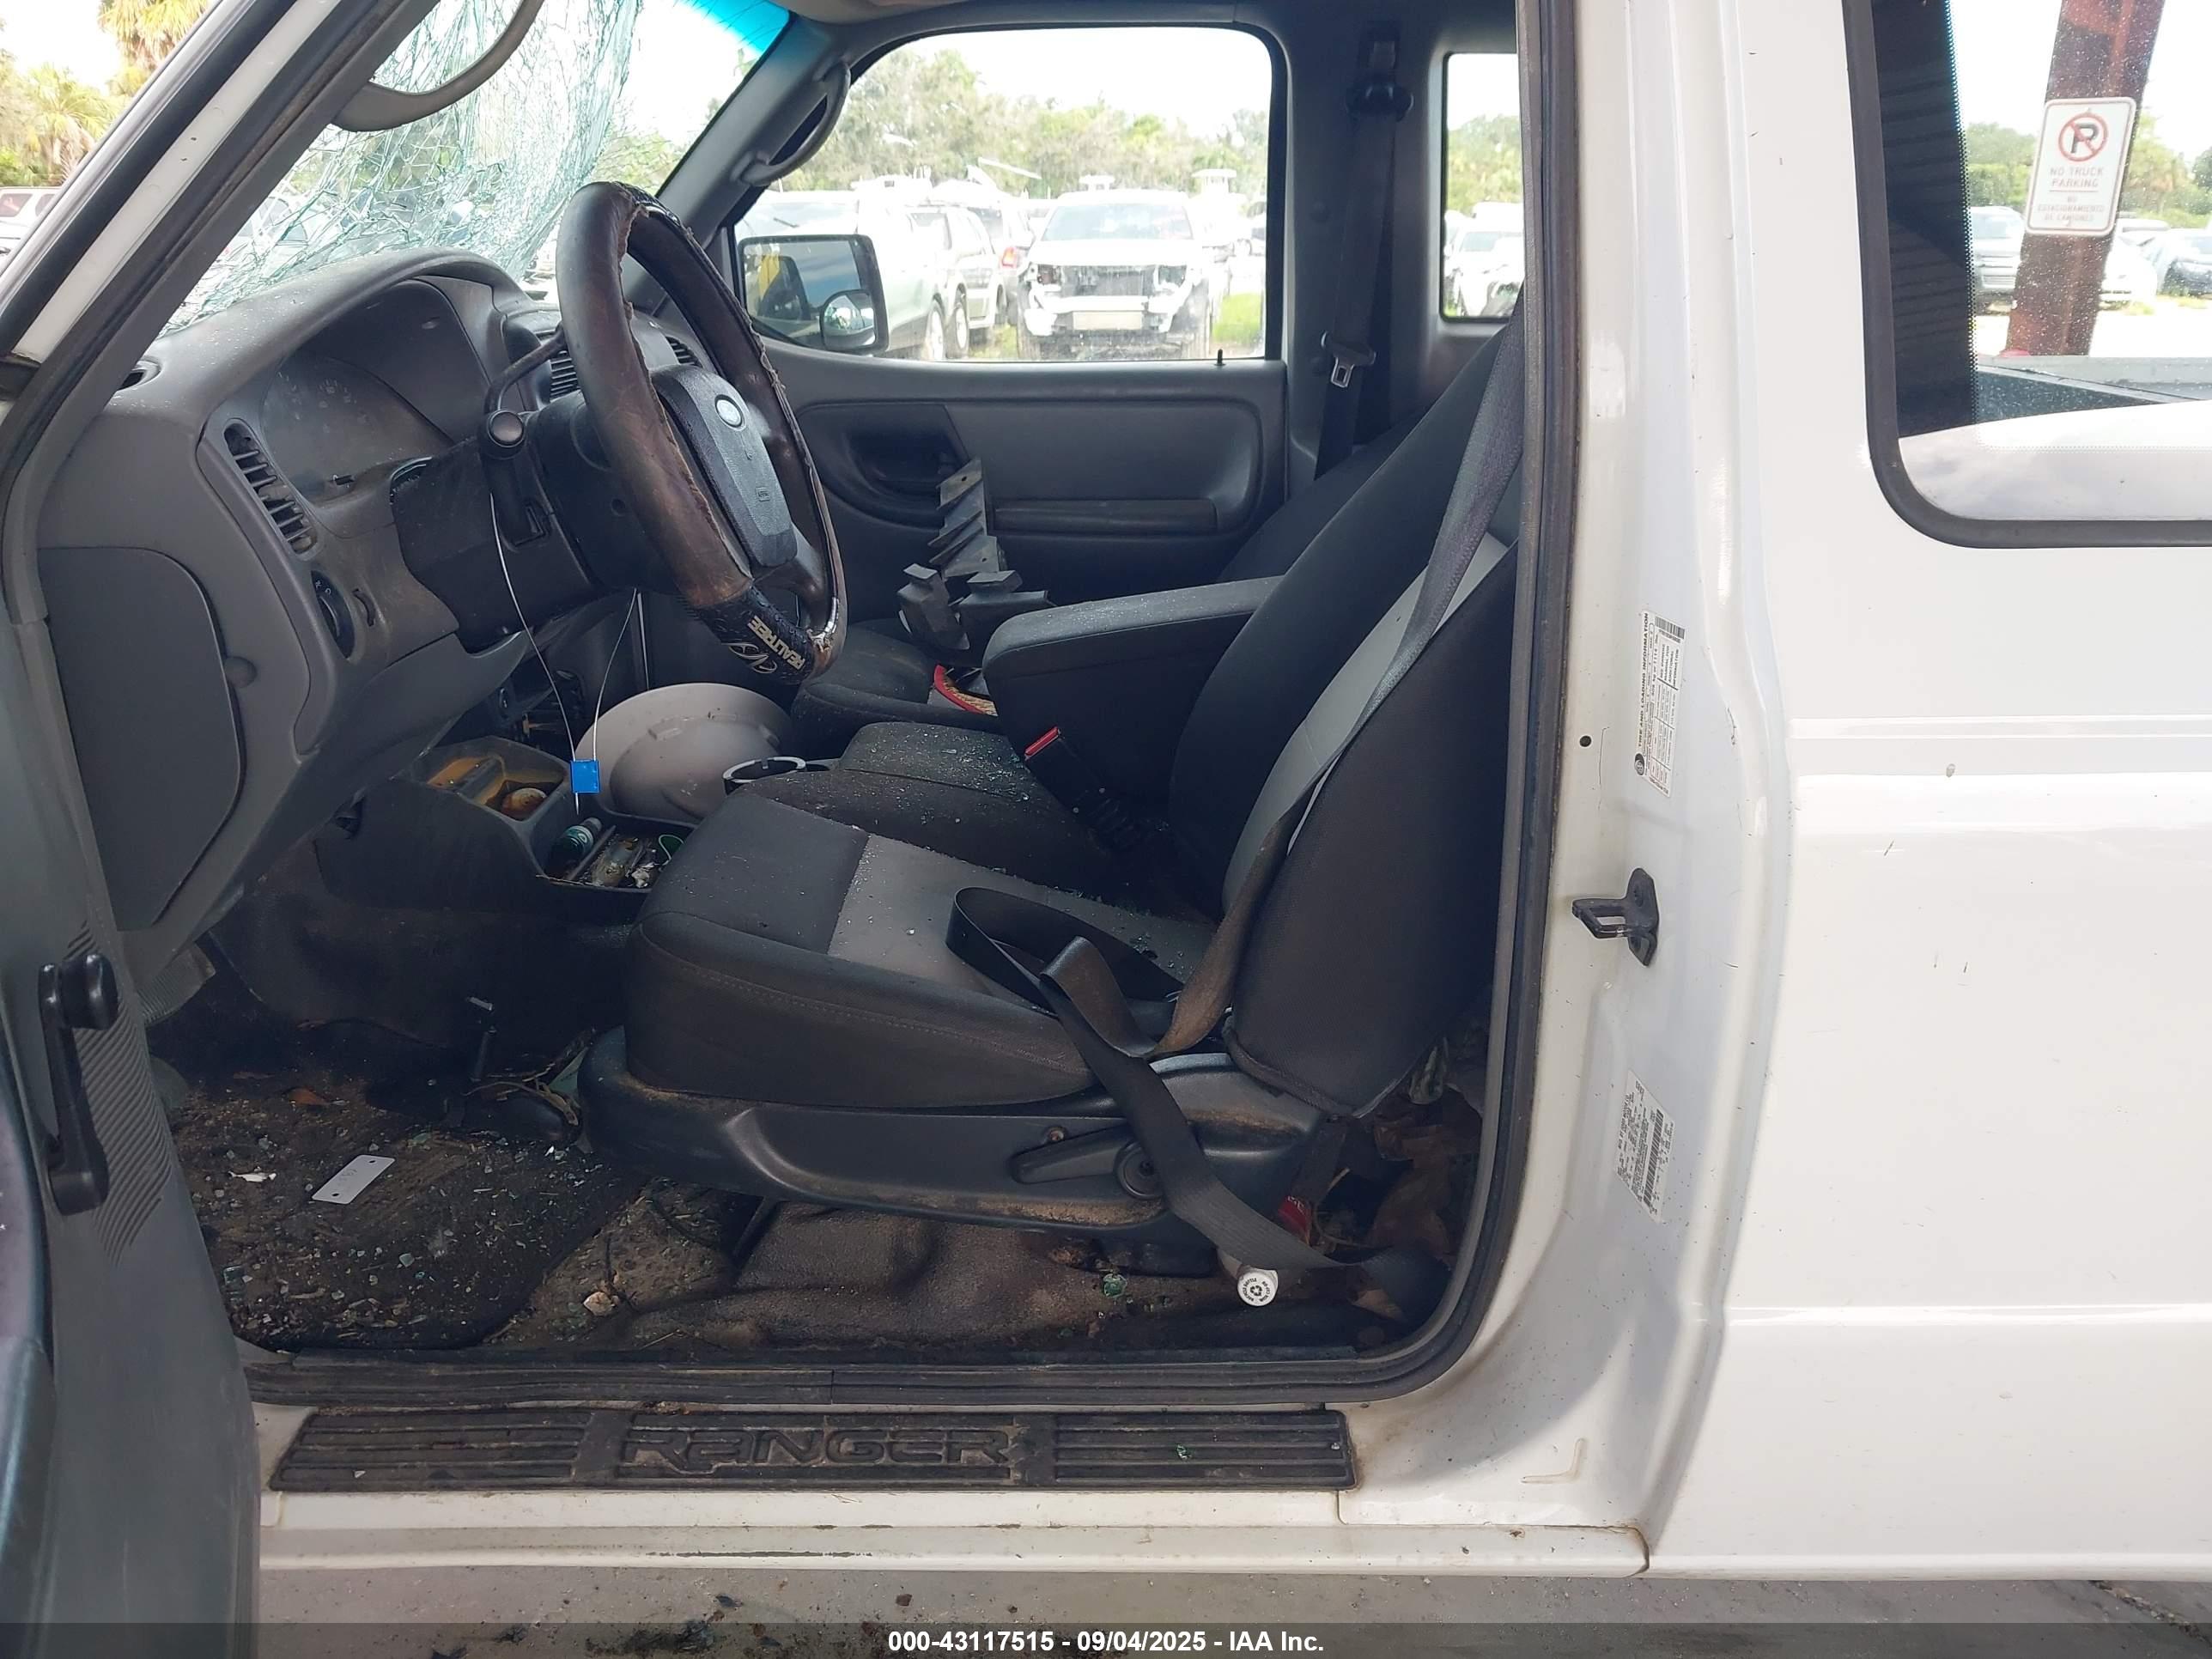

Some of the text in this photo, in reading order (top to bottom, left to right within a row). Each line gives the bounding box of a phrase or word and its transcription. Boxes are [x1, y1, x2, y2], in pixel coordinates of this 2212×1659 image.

[2050, 167, 2104, 177] NO TRUCK
[2051, 178, 2100, 187] PARKING
[747, 615, 805, 671] REALTREE
[625, 1428, 1011, 1465] RANGER
